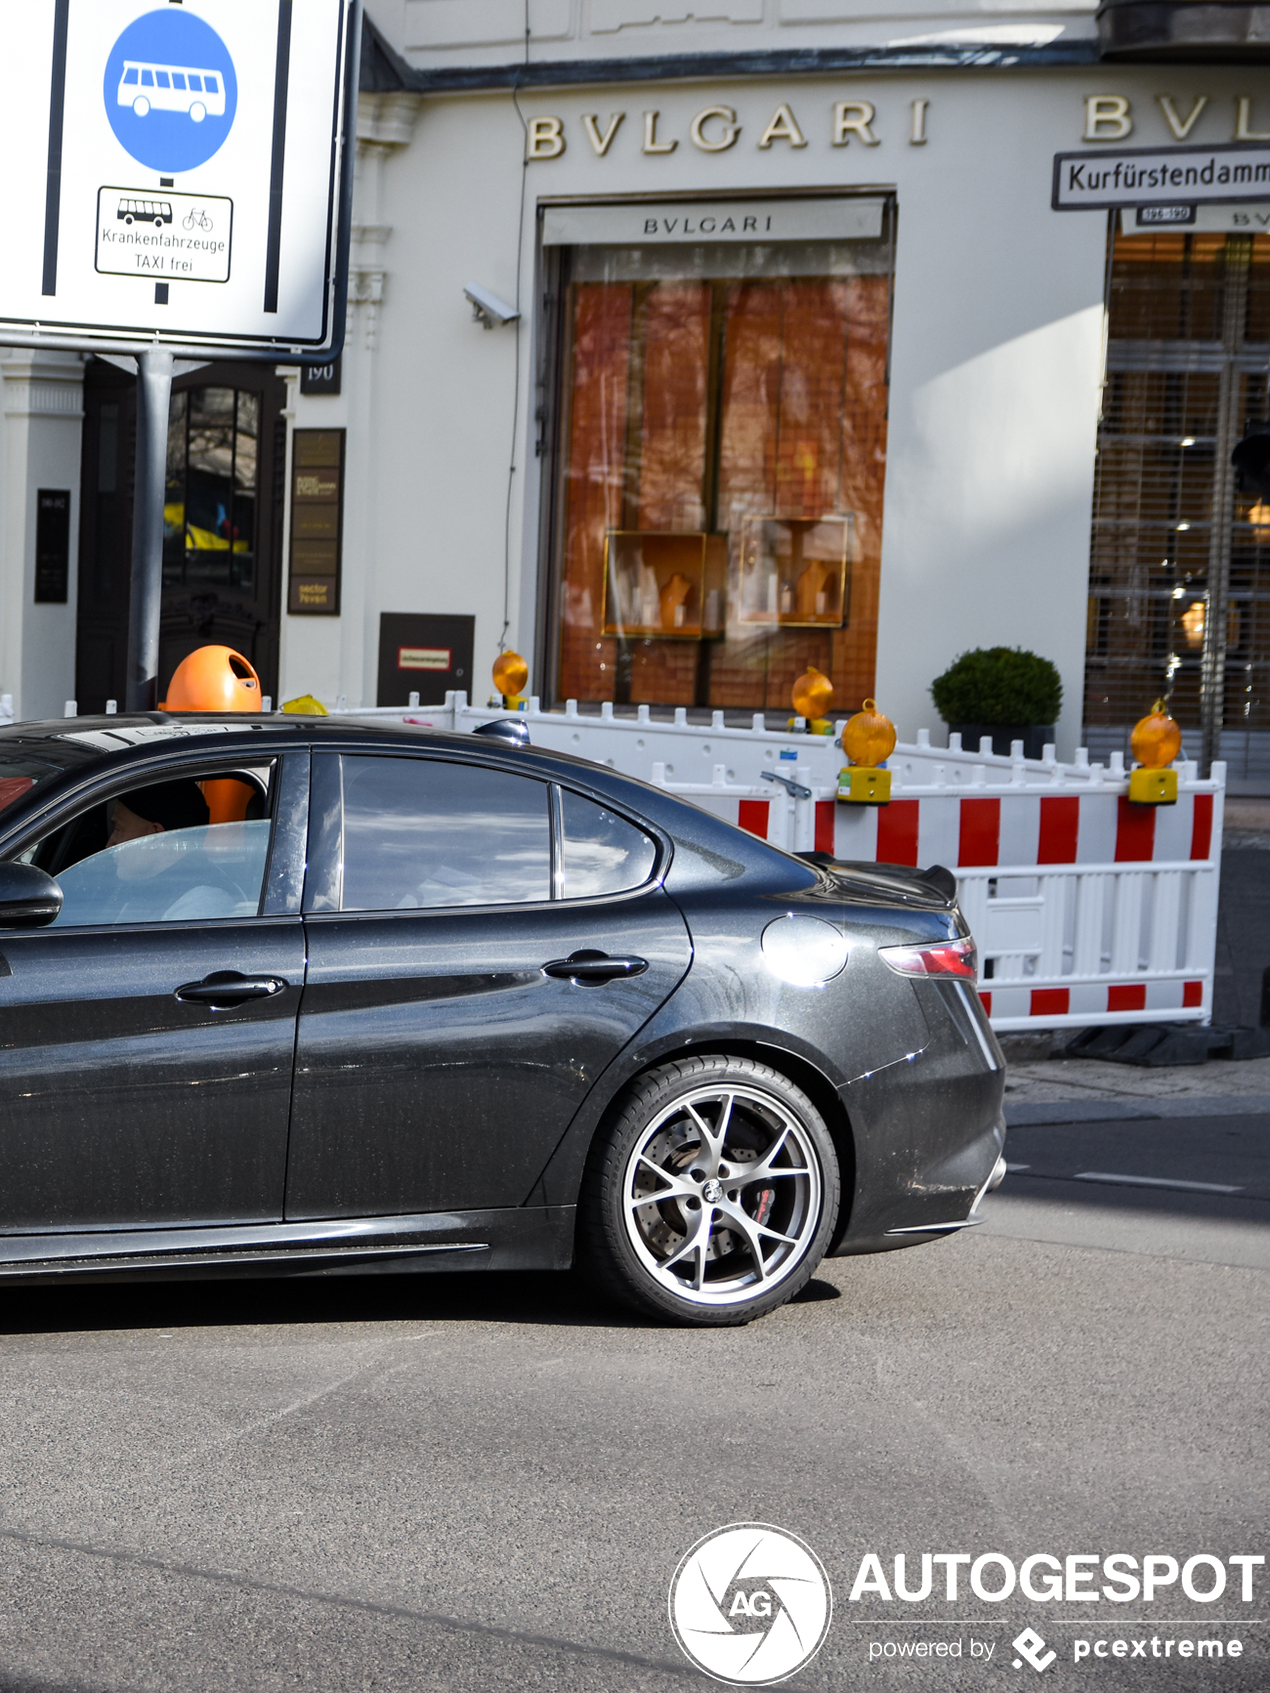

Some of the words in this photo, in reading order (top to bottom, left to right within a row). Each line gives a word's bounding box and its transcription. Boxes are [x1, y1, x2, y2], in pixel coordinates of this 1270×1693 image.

[527, 99, 929, 160] BVLGARI
[1083, 94, 1270, 142] BVL
[643, 216, 772, 234] BVLGARI
[102, 228, 225, 254] Krankenfahrzeuge
[135, 254, 164, 269] TAXI
[171, 257, 193, 272] frei
